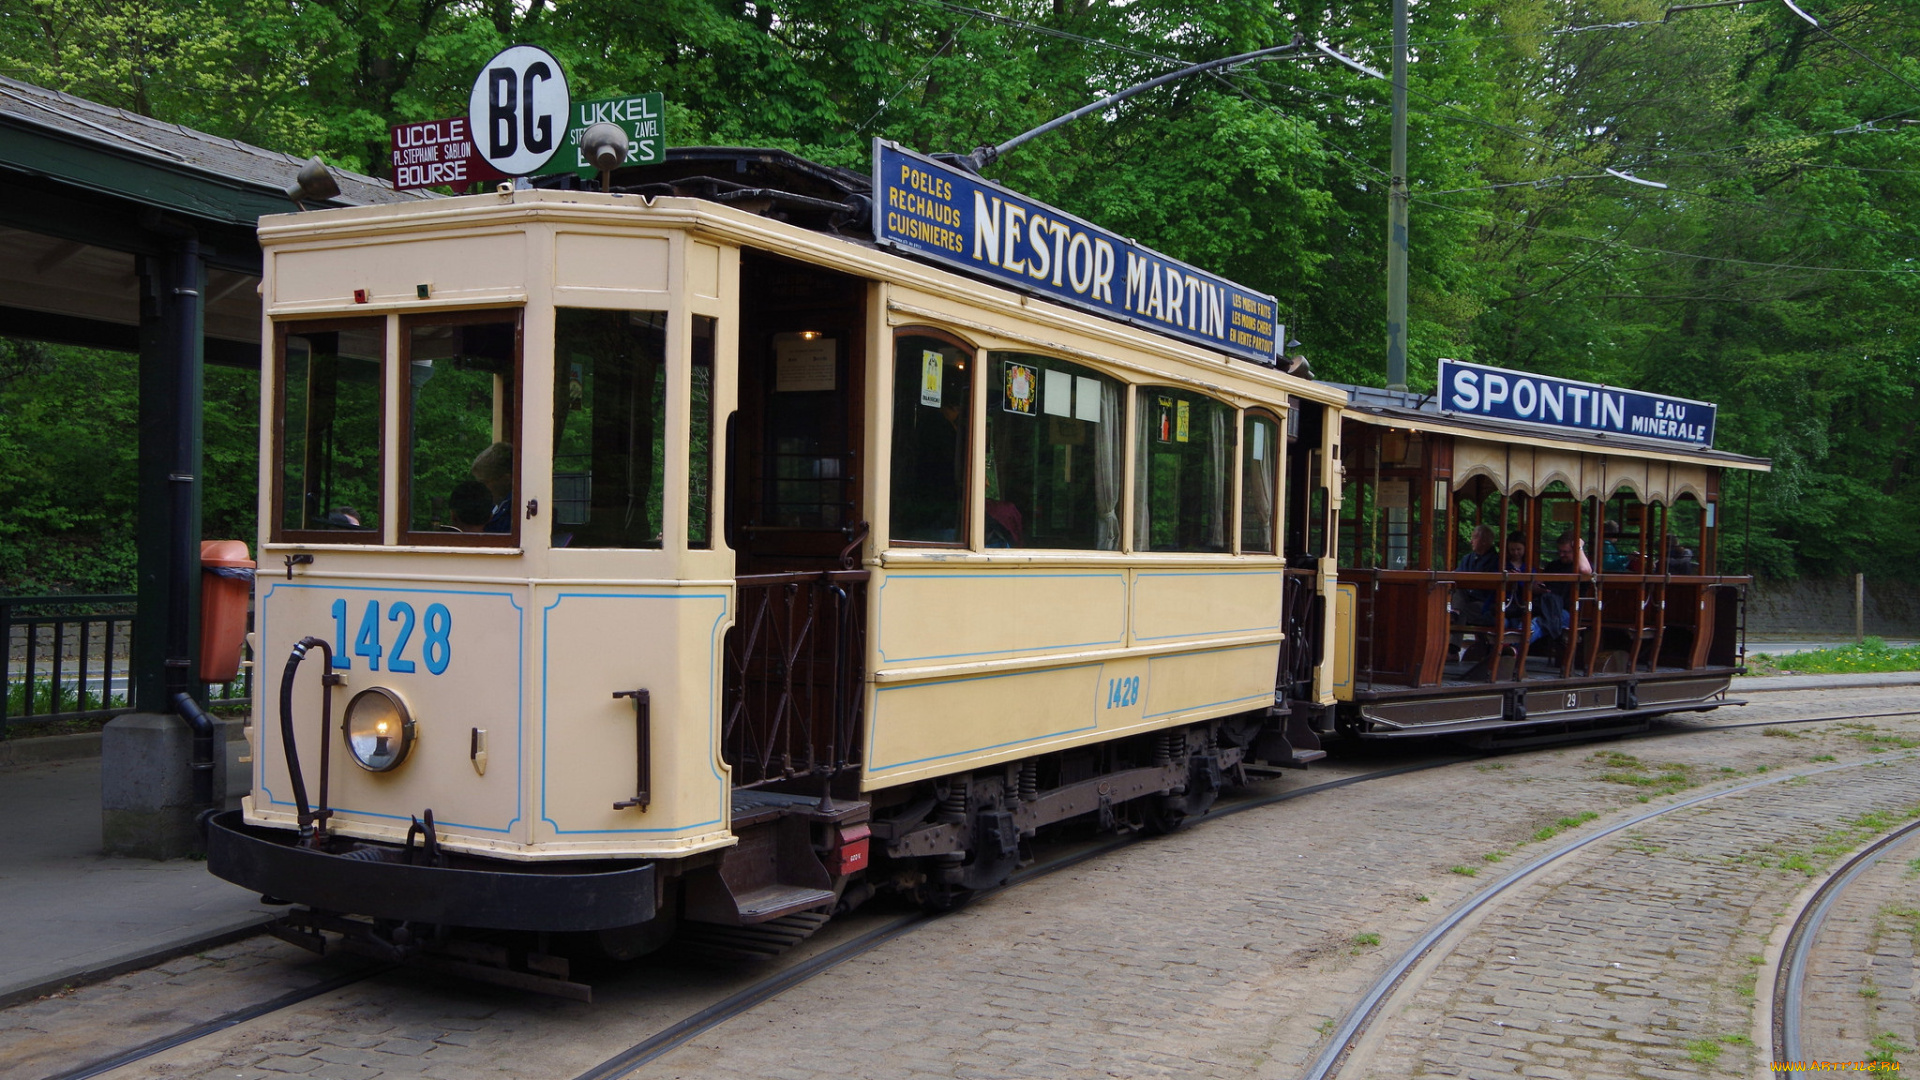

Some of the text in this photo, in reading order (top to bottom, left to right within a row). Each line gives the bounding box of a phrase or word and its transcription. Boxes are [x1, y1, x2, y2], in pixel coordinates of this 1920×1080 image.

[489, 61, 552, 159] BG
[581, 98, 658, 126] UKKEL
[397, 120, 464, 148] UCCLE
[635, 120, 659, 138] ZAVEL
[444, 141, 471, 160] SABLON
[397, 160, 467, 187] BOURSE
[901, 165, 952, 201] POELES
[889, 186, 961, 228] RECHAUDS
[888, 212, 963, 253] CUISINIERES
[972, 190, 1225, 339] NESTOR MARTIN
[1232, 293, 1241, 308] LES
[1232, 310, 1241, 325] LES
[1452, 369, 1625, 430] SPONTIN
[1655, 401, 1685, 421] EAU
[1631, 415, 1705, 441] MINERALE
[332, 598, 451, 675] 1428
[1107, 675, 1140, 709] 1428
[1567, 693, 1576, 707] 29
